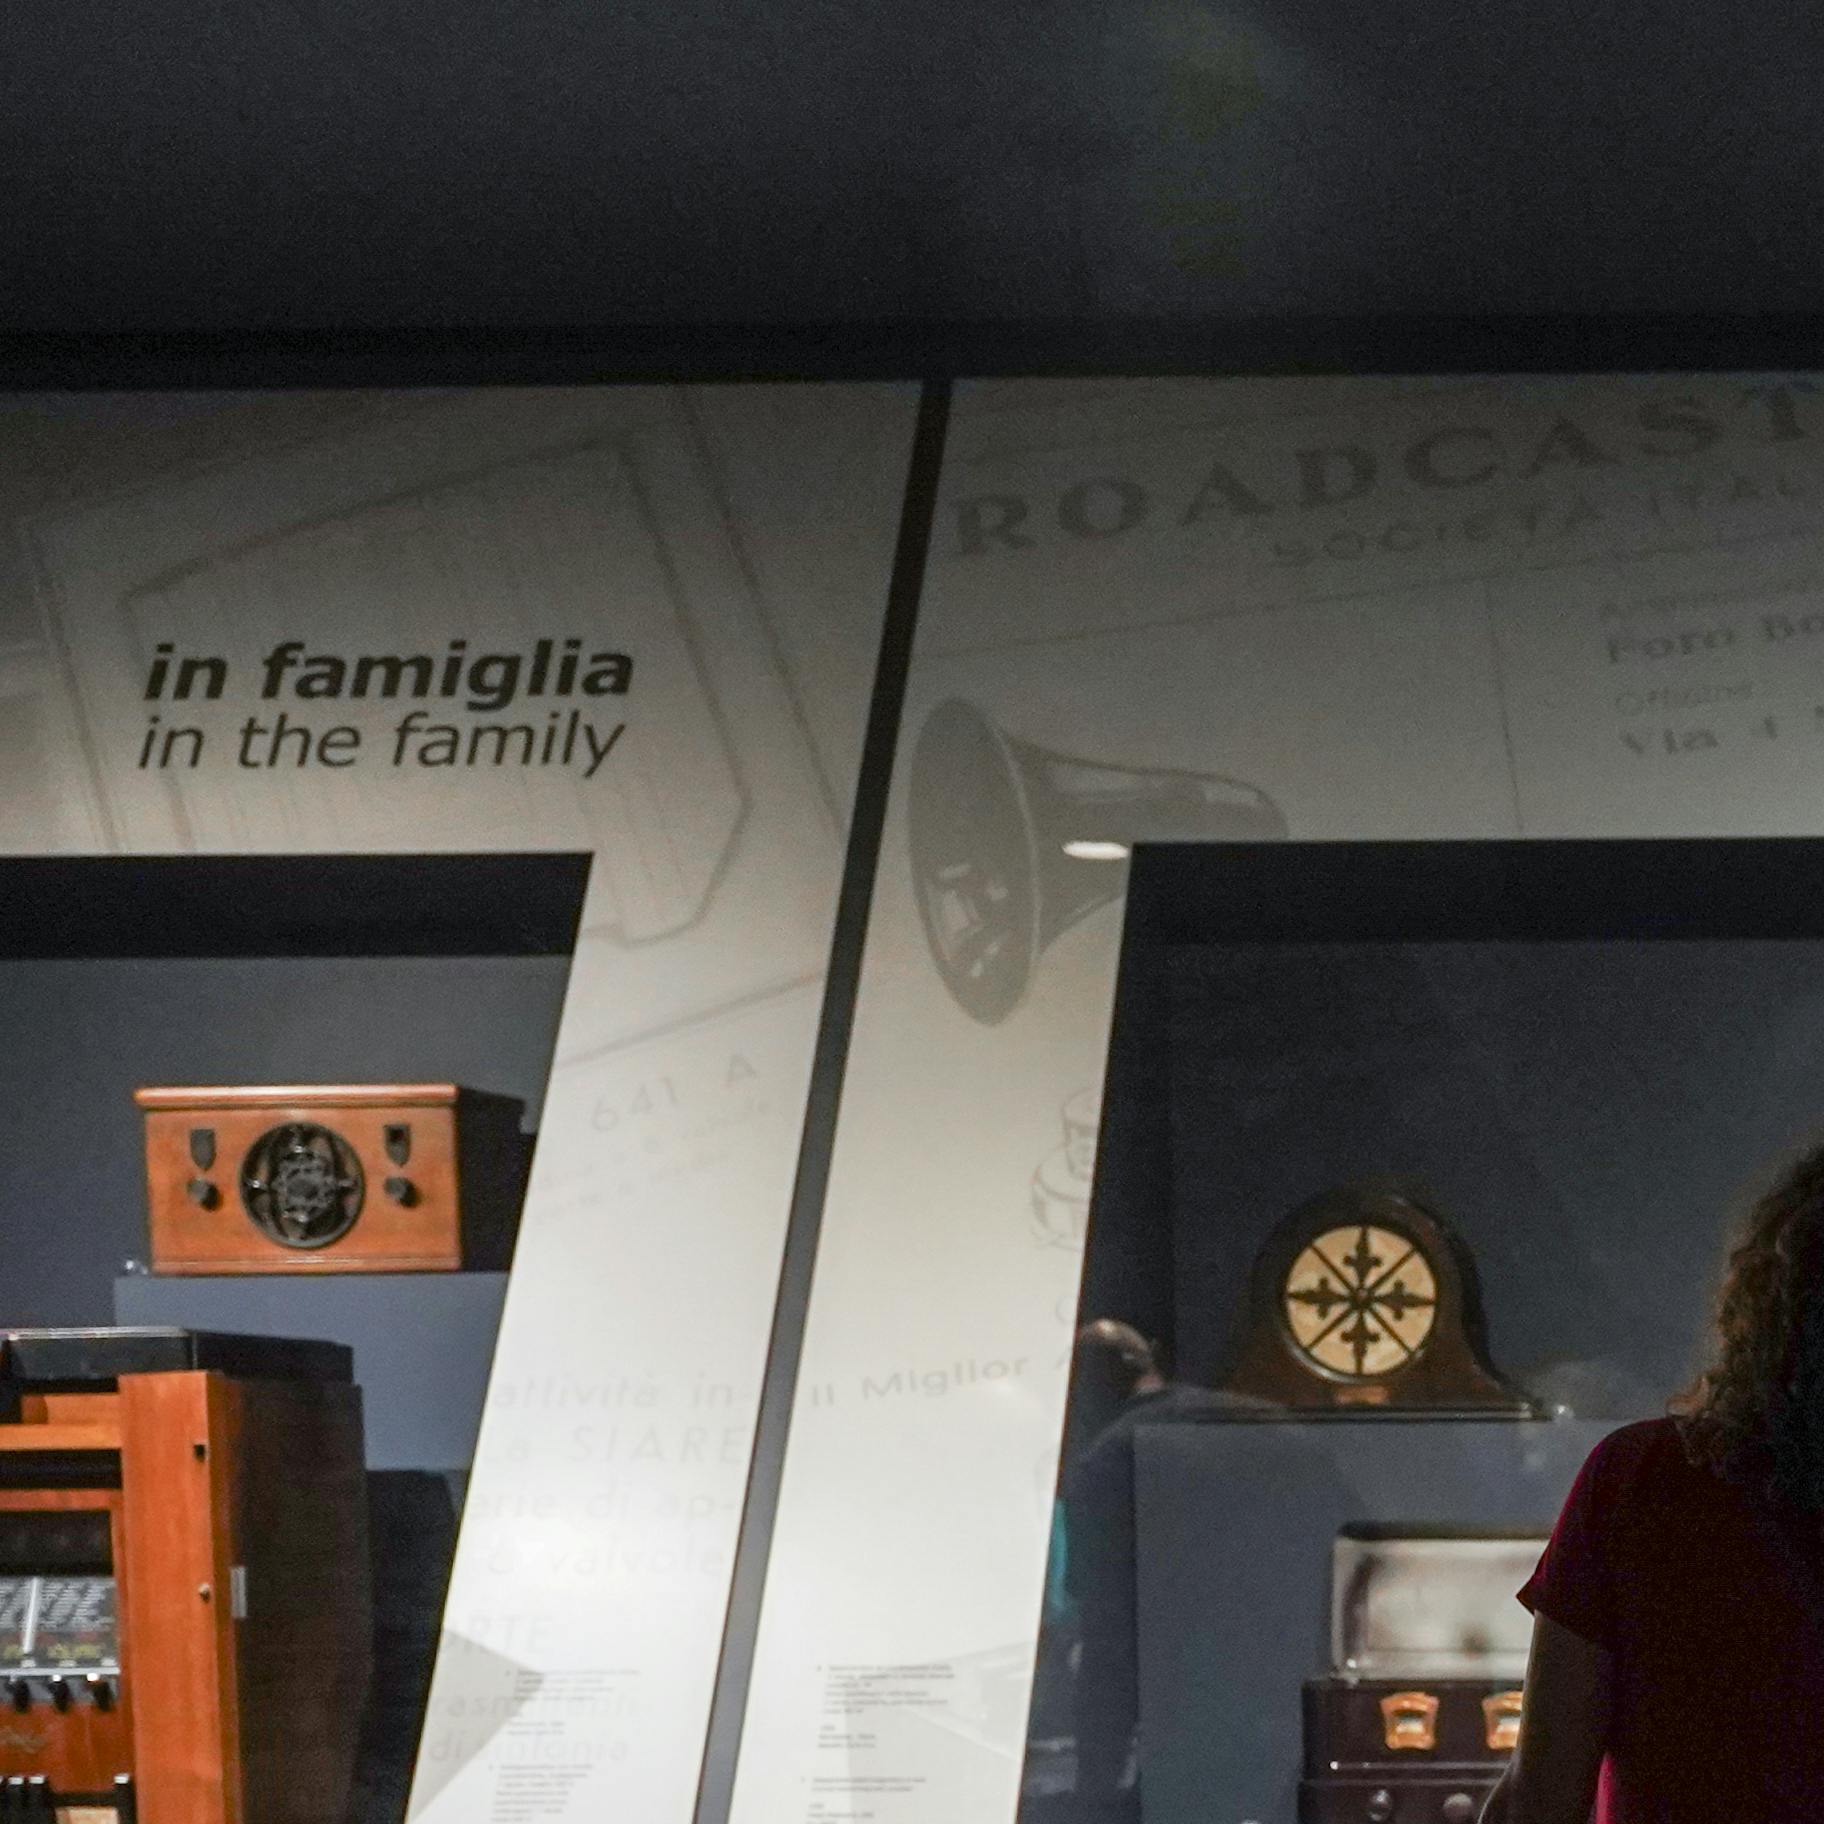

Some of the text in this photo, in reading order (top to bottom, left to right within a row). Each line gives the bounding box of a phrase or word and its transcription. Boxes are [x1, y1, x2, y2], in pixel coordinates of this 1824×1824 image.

[145, 638, 636, 713] in famiglia
[137, 707, 627, 779] in the family
